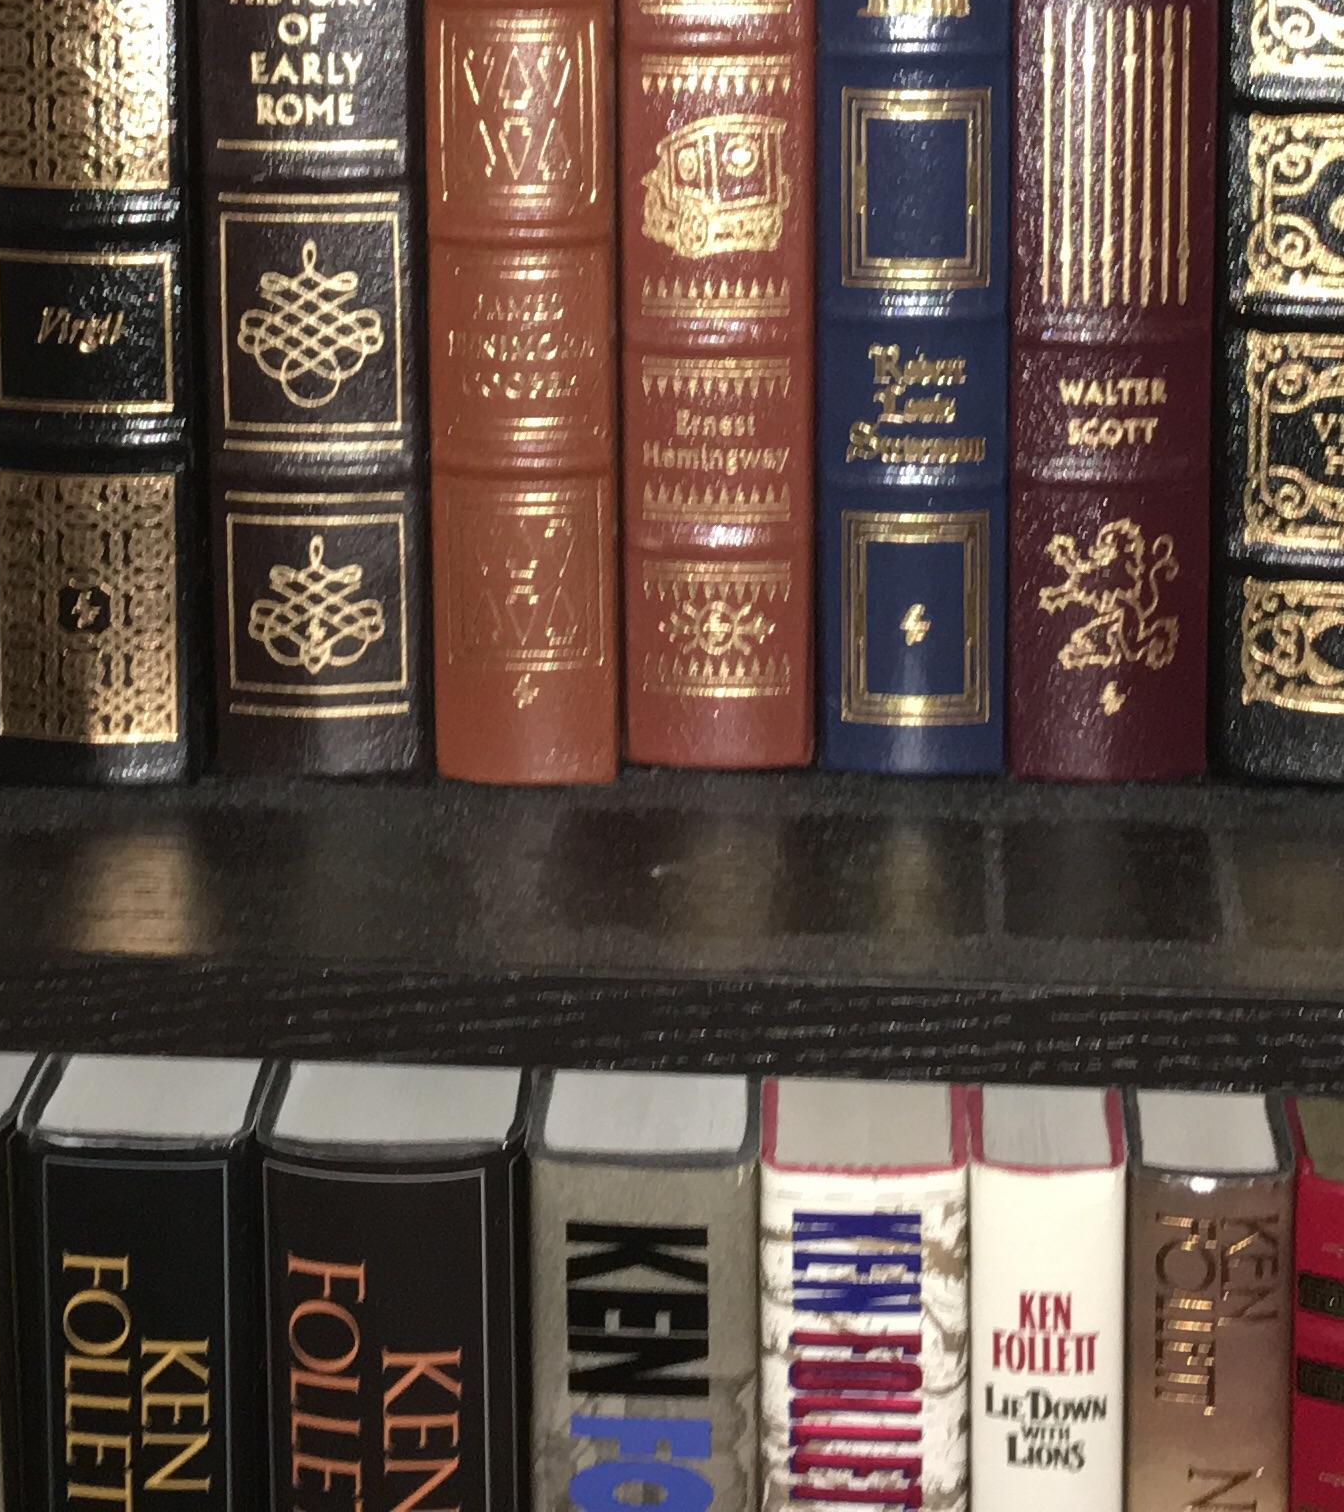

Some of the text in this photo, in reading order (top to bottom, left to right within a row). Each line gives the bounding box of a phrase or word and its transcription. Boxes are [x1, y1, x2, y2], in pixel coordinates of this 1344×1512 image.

[278, 12, 327, 45] OF
[250, 51, 363, 85] EARLY
[256, 92, 355, 126] ROME
[1057, 377, 1168, 406] WALTER
[1067, 417, 1159, 447] SCOTT
[642, 440, 791, 476] Hemingway
[792, 1212, 922, 1313] KEN
[1217, 1212, 1281, 1328] KEN
[566, 1220, 711, 1397] KEN
[1018, 1290, 1072, 1331] KEN
[1156, 1212, 1218, 1417] FOLLETT
[992, 1326, 1100, 1376] FOLLETT
[140, 1335, 213, 1494] KEN
[381, 1345, 463, 1512] KEN
[569, 1416, 715, 1512] FO
